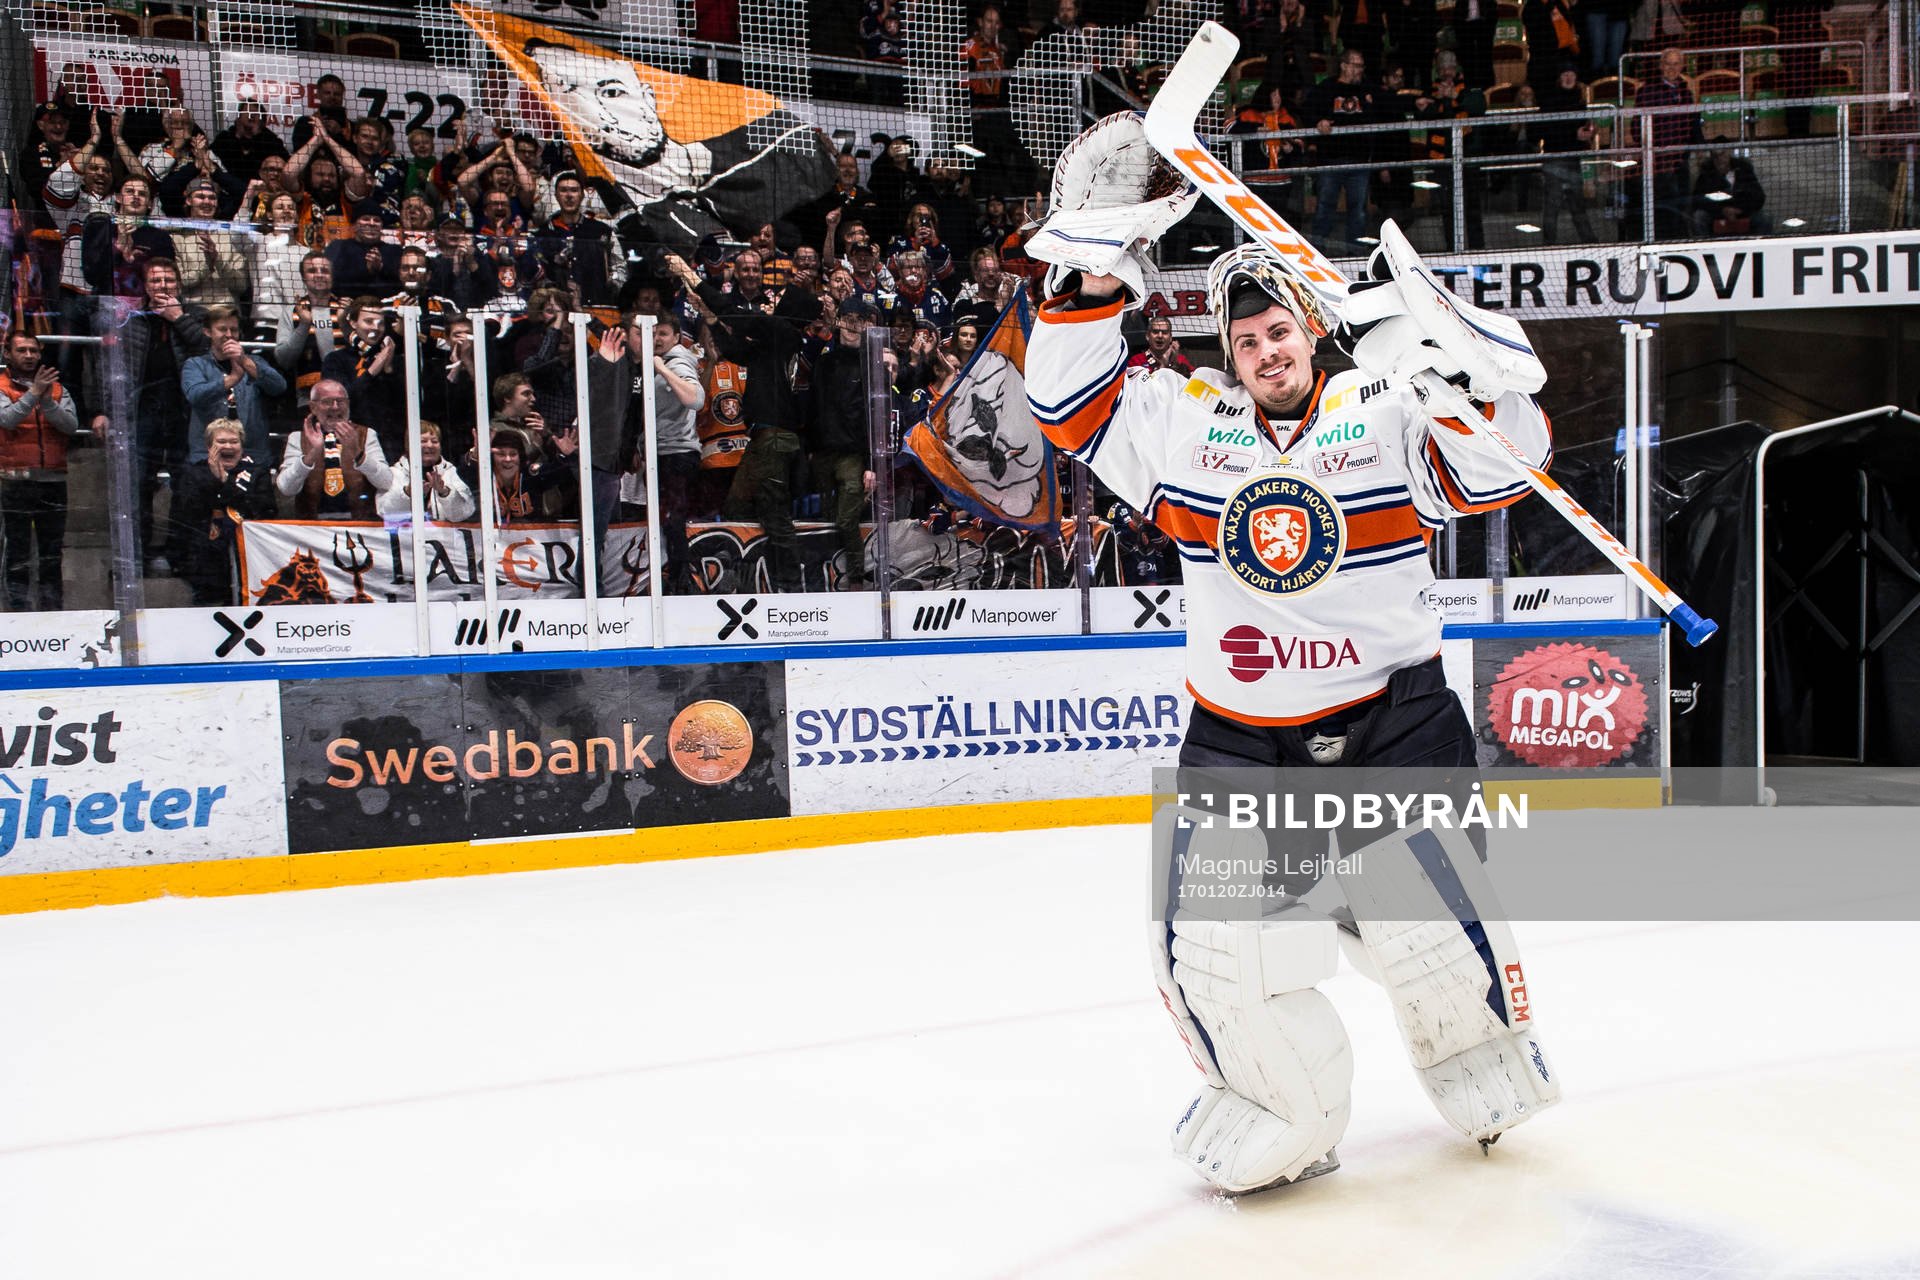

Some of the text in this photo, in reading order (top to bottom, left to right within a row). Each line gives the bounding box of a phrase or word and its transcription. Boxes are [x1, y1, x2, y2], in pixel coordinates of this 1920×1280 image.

[1173, 147, 1345, 283] CCM
[1430, 261, 1546, 309] TER
[1793, 244, 1920, 296] FRIT
[1208, 427, 1256, 447] wilo
[1315, 421, 1366, 448] wilo
[1222, 463, 1250, 475] PRODUKT
[1346, 454, 1378, 470] PRODUKT
[1226, 481, 1337, 542] VÄXJÖ LAKERS HOCKEY
[1236, 557, 1329, 592] STORT HJÄRTA
[1428, 593, 1478, 607] Experis
[1553, 593, 1615, 607] Manpower
[767, 607, 829, 627] Experis
[971, 606, 1058, 627] Manpower
[275, 620, 352, 641] Experis
[767, 629, 829, 638] ManpowerGroup
[0, 636, 70, 658] power
[276, 643, 352, 656] ManpowerGroup
[1270, 635, 1362, 670] VIDA
[794, 694, 1181, 747] SYDSTÄLLNINGAR
[1508, 726, 1614, 751] MEGAPOL
[325, 722, 656, 790] Swedbank
[1504, 960, 1531, 1022] CCM
